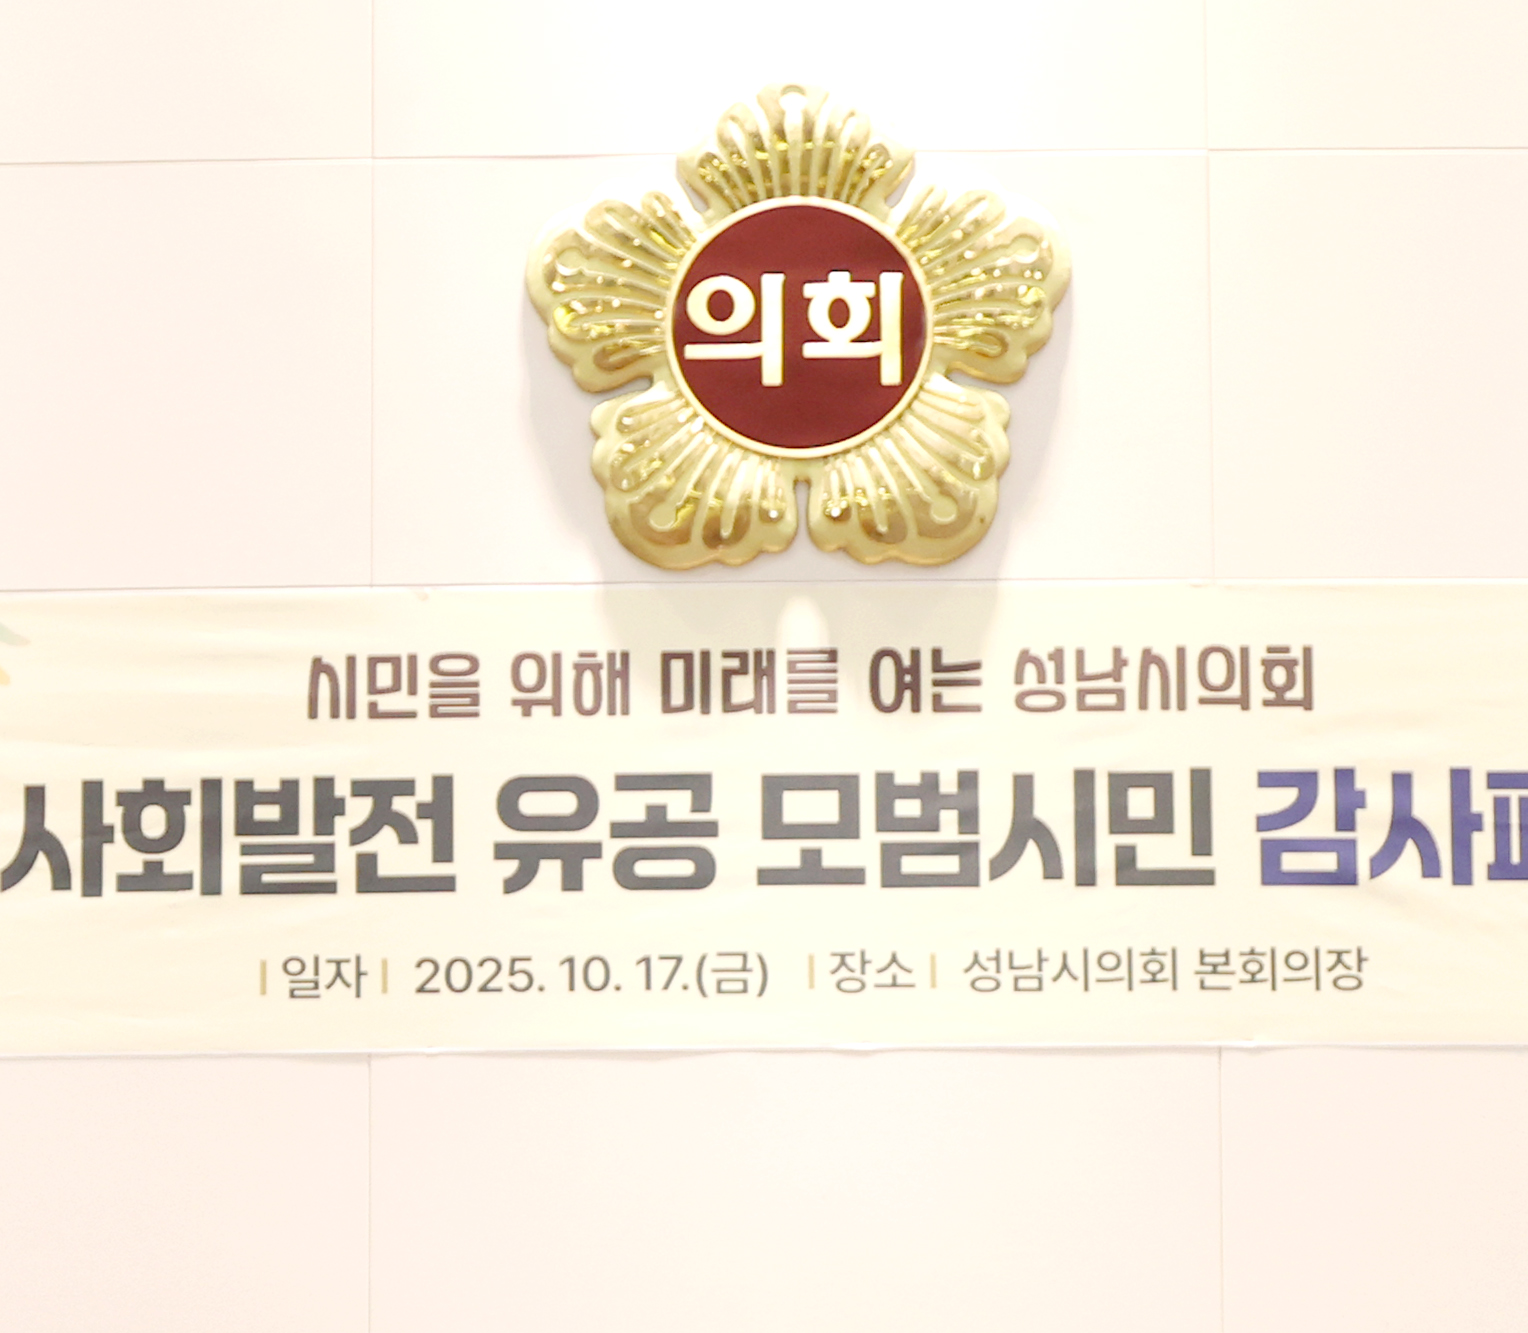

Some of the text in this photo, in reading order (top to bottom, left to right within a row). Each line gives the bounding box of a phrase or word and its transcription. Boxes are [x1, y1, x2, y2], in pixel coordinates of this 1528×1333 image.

[683, 270, 906, 387] 의회
[306, 644, 1315, 721] 시민을 위해 미래를 여는 성남시의회
[492, 772, 720, 896] 유공
[755, 766, 1217, 890] 모범시민
[281, 954, 369, 1000] 일자
[414, 956, 546, 995] 2025.
[559, 955, 622, 993] 10.
[829, 949, 916, 995] 장소
[963, 946, 1179, 994] 성남시의회
[1194, 946, 1369, 993] 본회의장
